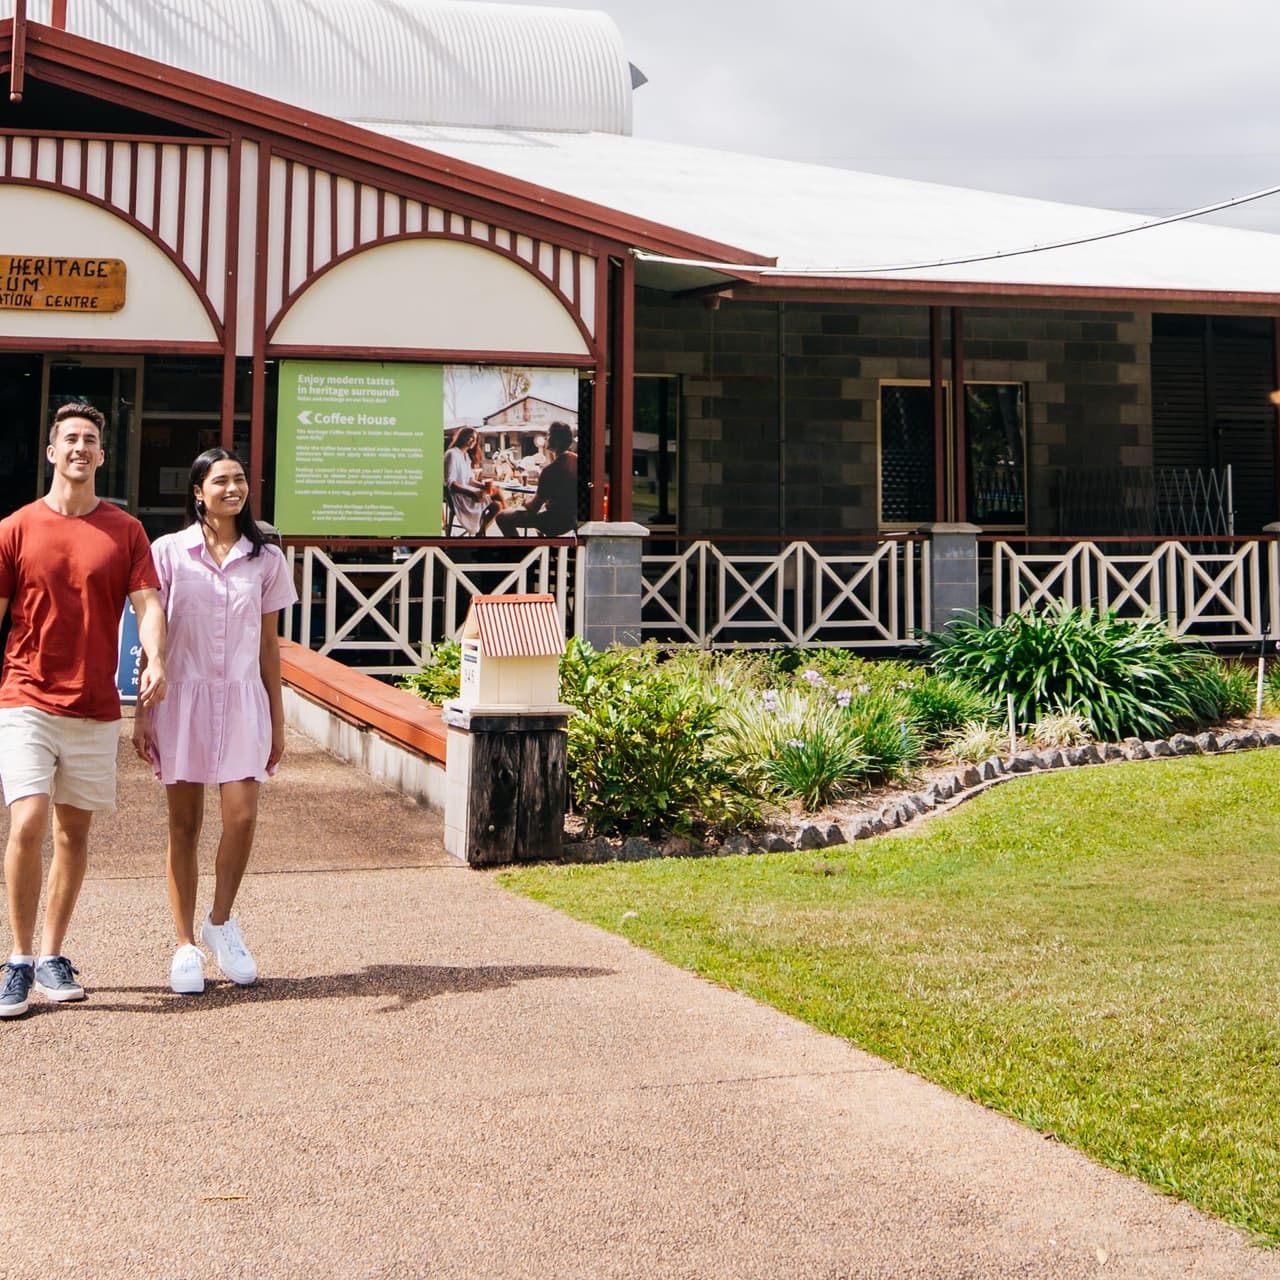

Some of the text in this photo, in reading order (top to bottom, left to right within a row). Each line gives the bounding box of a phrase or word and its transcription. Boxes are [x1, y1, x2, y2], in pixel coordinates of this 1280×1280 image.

[10, 258, 109, 278] HERITAGE
[45, 294, 98, 308] CENTRE
[298, 374, 395, 386] Enjoy modern tastes
[297, 385, 400, 397] in heritage surrounds
[314, 412, 397, 426] Coffee House
